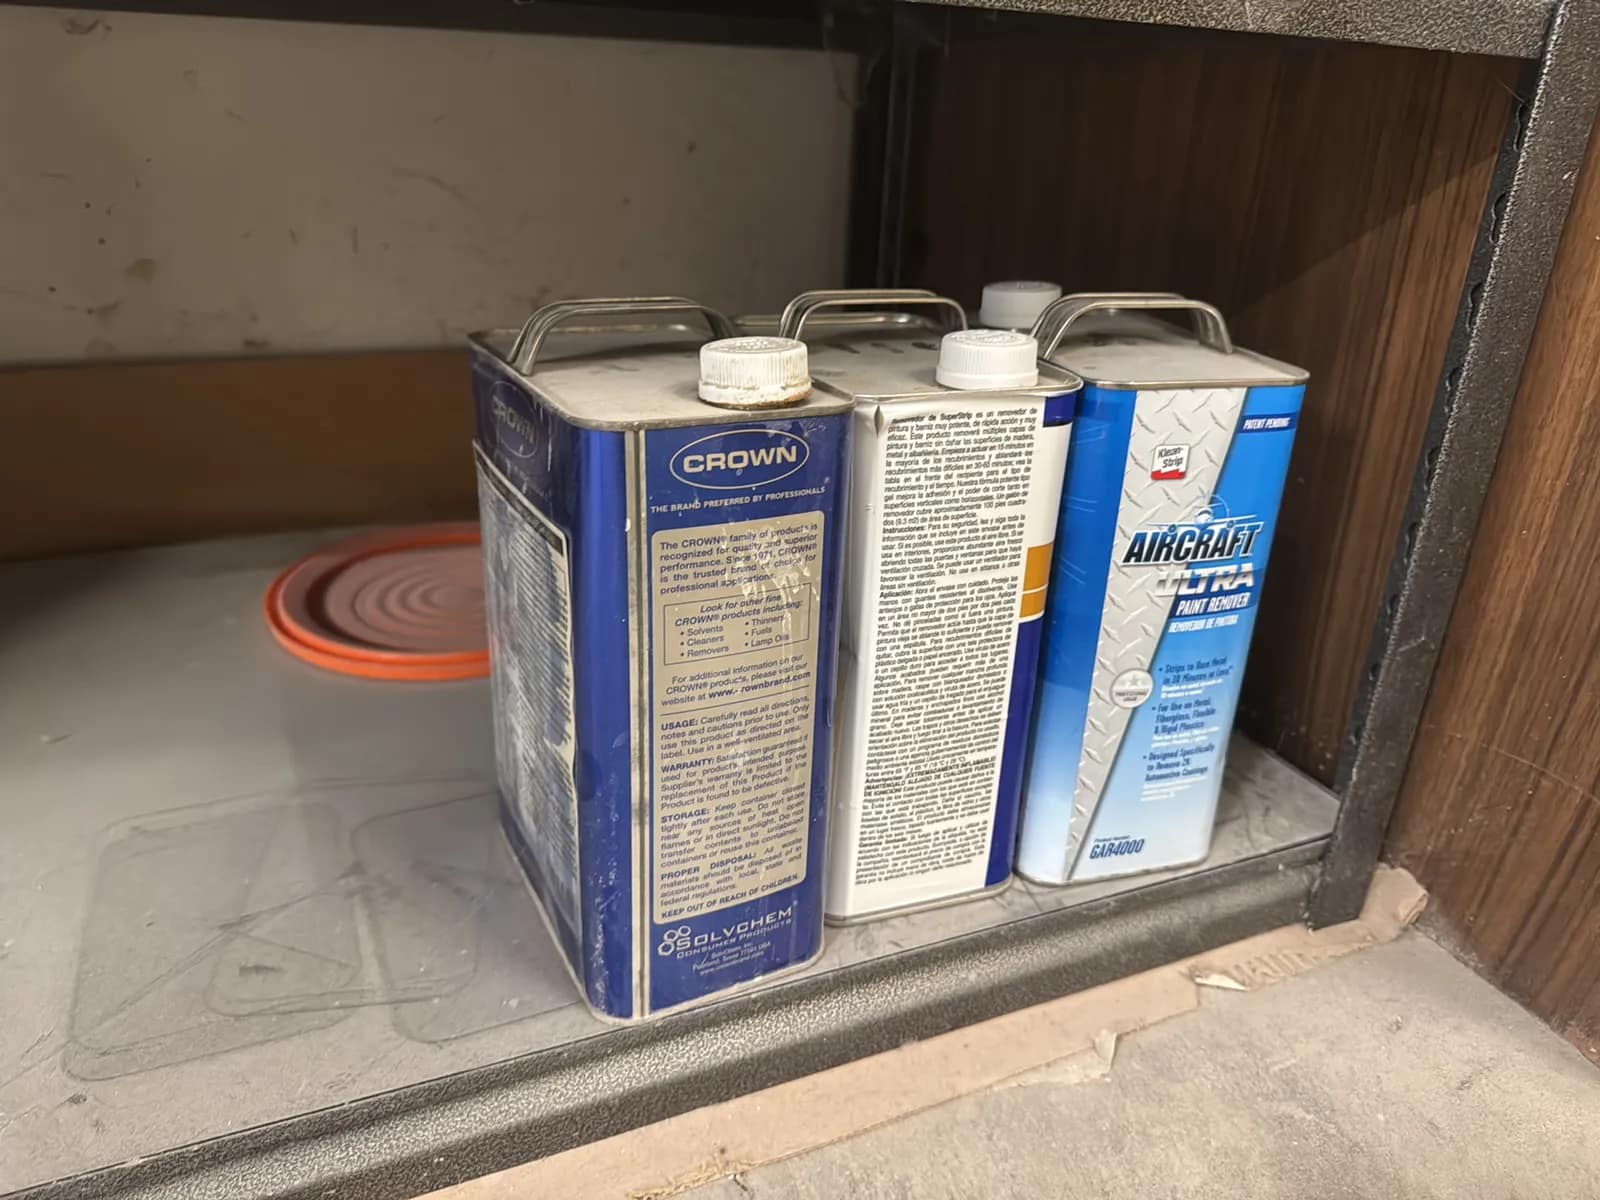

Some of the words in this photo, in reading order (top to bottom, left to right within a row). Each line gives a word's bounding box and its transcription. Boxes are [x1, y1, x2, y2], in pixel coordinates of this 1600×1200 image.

[997, 408, 1026, 416] removedor
[1243, 418, 1266, 430] PATENT
[1265, 417, 1290, 429] PENDING
[910, 432, 923, 440] Este
[926, 430, 950, 439] producto
[682, 445, 797, 474] CROWN
[1162, 456, 1183, 468] Strip
[671, 502, 701, 511] BRAND
[704, 496, 750, 508] PREFERRED
[765, 486, 826, 500] PROFESSIONALS
[660, 542, 678, 550] The
[730, 531, 756, 543] family
[760, 531, 768, 539] of
[660, 549, 713, 561] recognized
[765, 540, 781, 548] and
[785, 534, 817, 545] superior
[1121, 522, 1263, 564] AIRCRAFT
[660, 559, 723, 573] performance.
[726, 556, 750, 564] Since
[753, 551, 776, 561] 1971,
[673, 573, 688, 581] the
[693, 569, 726, 577] trusted
[731, 564, 756, 574] brand
[761, 562, 769, 570] of
[805, 554, 816, 562] for
[661, 580, 718, 595] professional
[1156, 563, 1253, 596] ULTRA
[700, 602, 722, 613] Look
[725, 601, 738, 610] for
[740, 598, 763, 608] other
[765, 595, 781, 603] fine
[721, 608, 760, 621] products
[1176, 598, 1208, 616] PAINT
[1208, 593, 1251, 612] REMOVER
[687, 626, 724, 636] Solvents
[752, 615, 785, 626] Thinners
[752, 626, 772, 635] Fuels
[687, 636, 724, 646] Cleaners
[687, 646, 729, 657] Removers
[751, 636, 773, 647] Lamp
[672, 676, 686, 684] For
[689, 669, 730, 681] additional
[733, 659, 777, 673] information
[710, 675, 748, 689] products,
[751, 670, 776, 681] please
[661, 696, 695, 707] website
[709, 671, 811, 699] www.rownbrand.com
[661, 719, 698, 731] USAGE:
[701, 711, 738, 725] Carefully
[740, 708, 759, 717] read
[760, 704, 769, 712] all
[661, 731, 686, 741] notes
[688, 728, 705, 736] and
[707, 721, 743, 733] cautions
[744, 717, 764, 727] prior
[793, 704, 809, 714] Only
[661, 742, 677, 750] use
[681, 738, 697, 746] this
[700, 731, 734, 745] product
[750, 722, 782, 734] directed
[798, 714, 808, 722] the
[661, 751, 685, 760] label.
[688, 746, 704, 755] Use
[724, 728, 781, 748] well-ventilated
[661, 757, 714, 773] WARRANTY:
[661, 808, 710, 823] STORAGE:
[1089, 838, 1144, 859] GAR4000
[661, 867, 700, 880] PROPER
[710, 853, 756, 870] DISPOSAL:
[661, 908, 685, 918] KEEP
[687, 901, 705, 912] OUT
[707, 899, 717, 907] OF
[719, 890, 747, 903] REACH
[749, 886, 759, 895] OF
[676, 907, 792, 951] SOLVCHEM
[677, 937, 736, 959] CONSUMER
